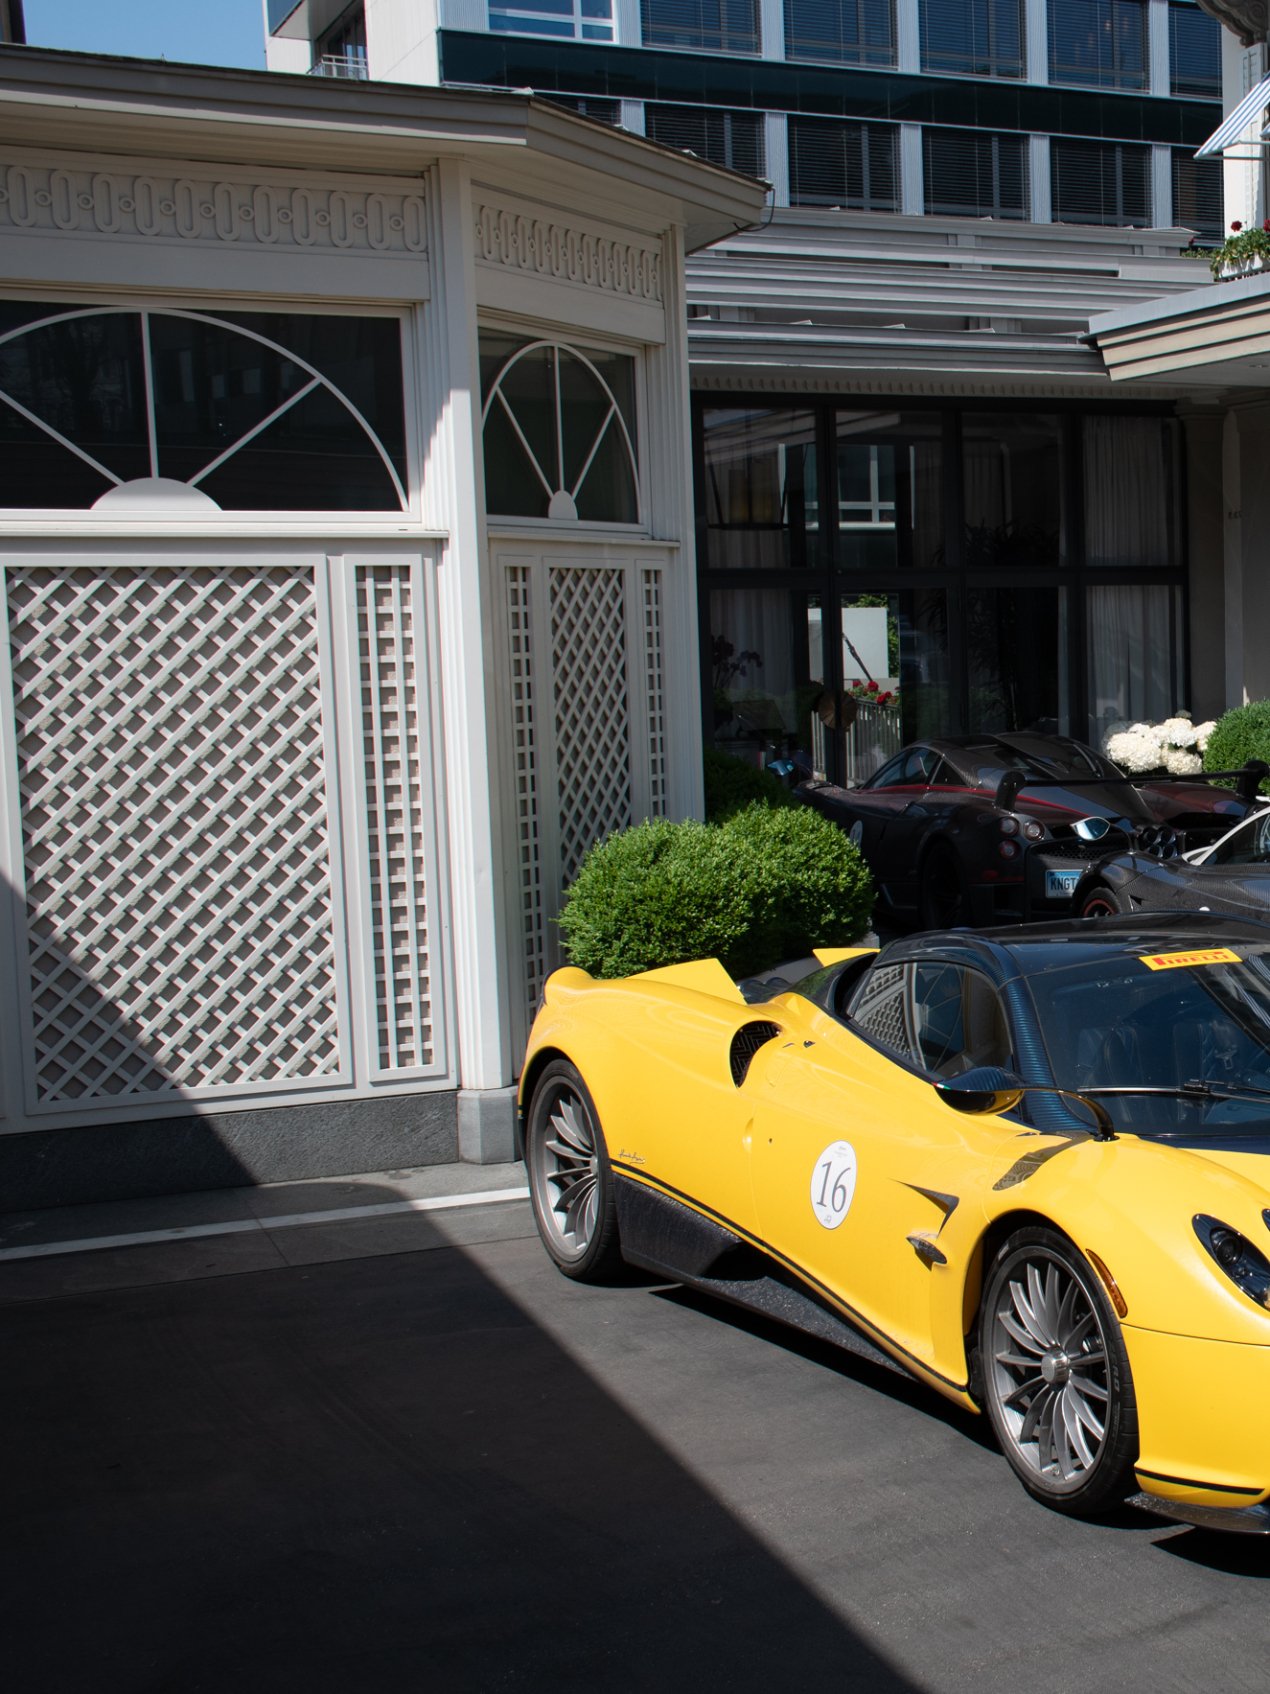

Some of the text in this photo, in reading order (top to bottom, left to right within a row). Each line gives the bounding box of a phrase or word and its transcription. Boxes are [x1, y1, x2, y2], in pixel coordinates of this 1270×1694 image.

[1050, 877, 1080, 890] KNGT
[1152, 951, 1230, 966] PIRELLI
[816, 1160, 851, 1213] 16
